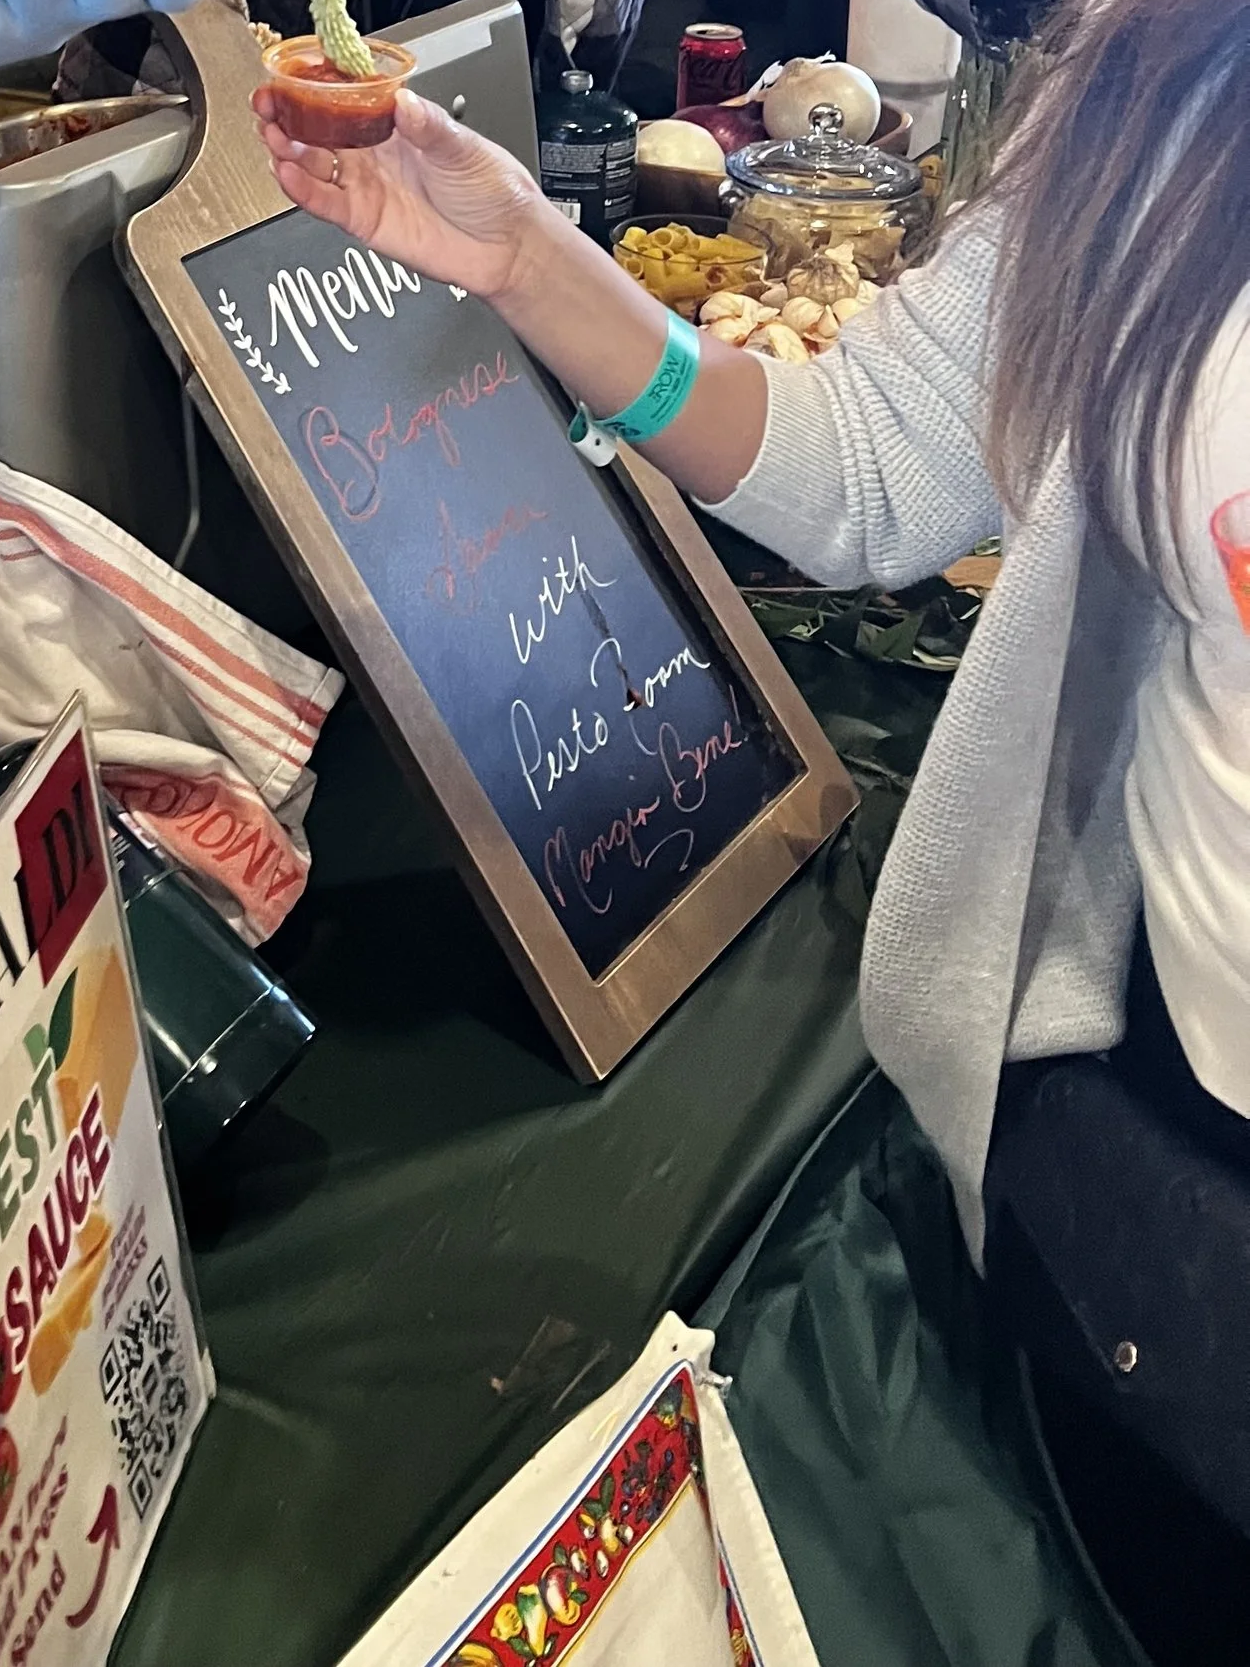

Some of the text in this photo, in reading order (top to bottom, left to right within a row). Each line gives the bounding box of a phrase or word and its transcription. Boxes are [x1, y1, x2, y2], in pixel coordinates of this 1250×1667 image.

[269, 247, 421, 368] Menu
[509, 535, 618, 664] with
[510, 699, 608, 811] Pesto
[5, 1090, 110, 1367] SAUCE
